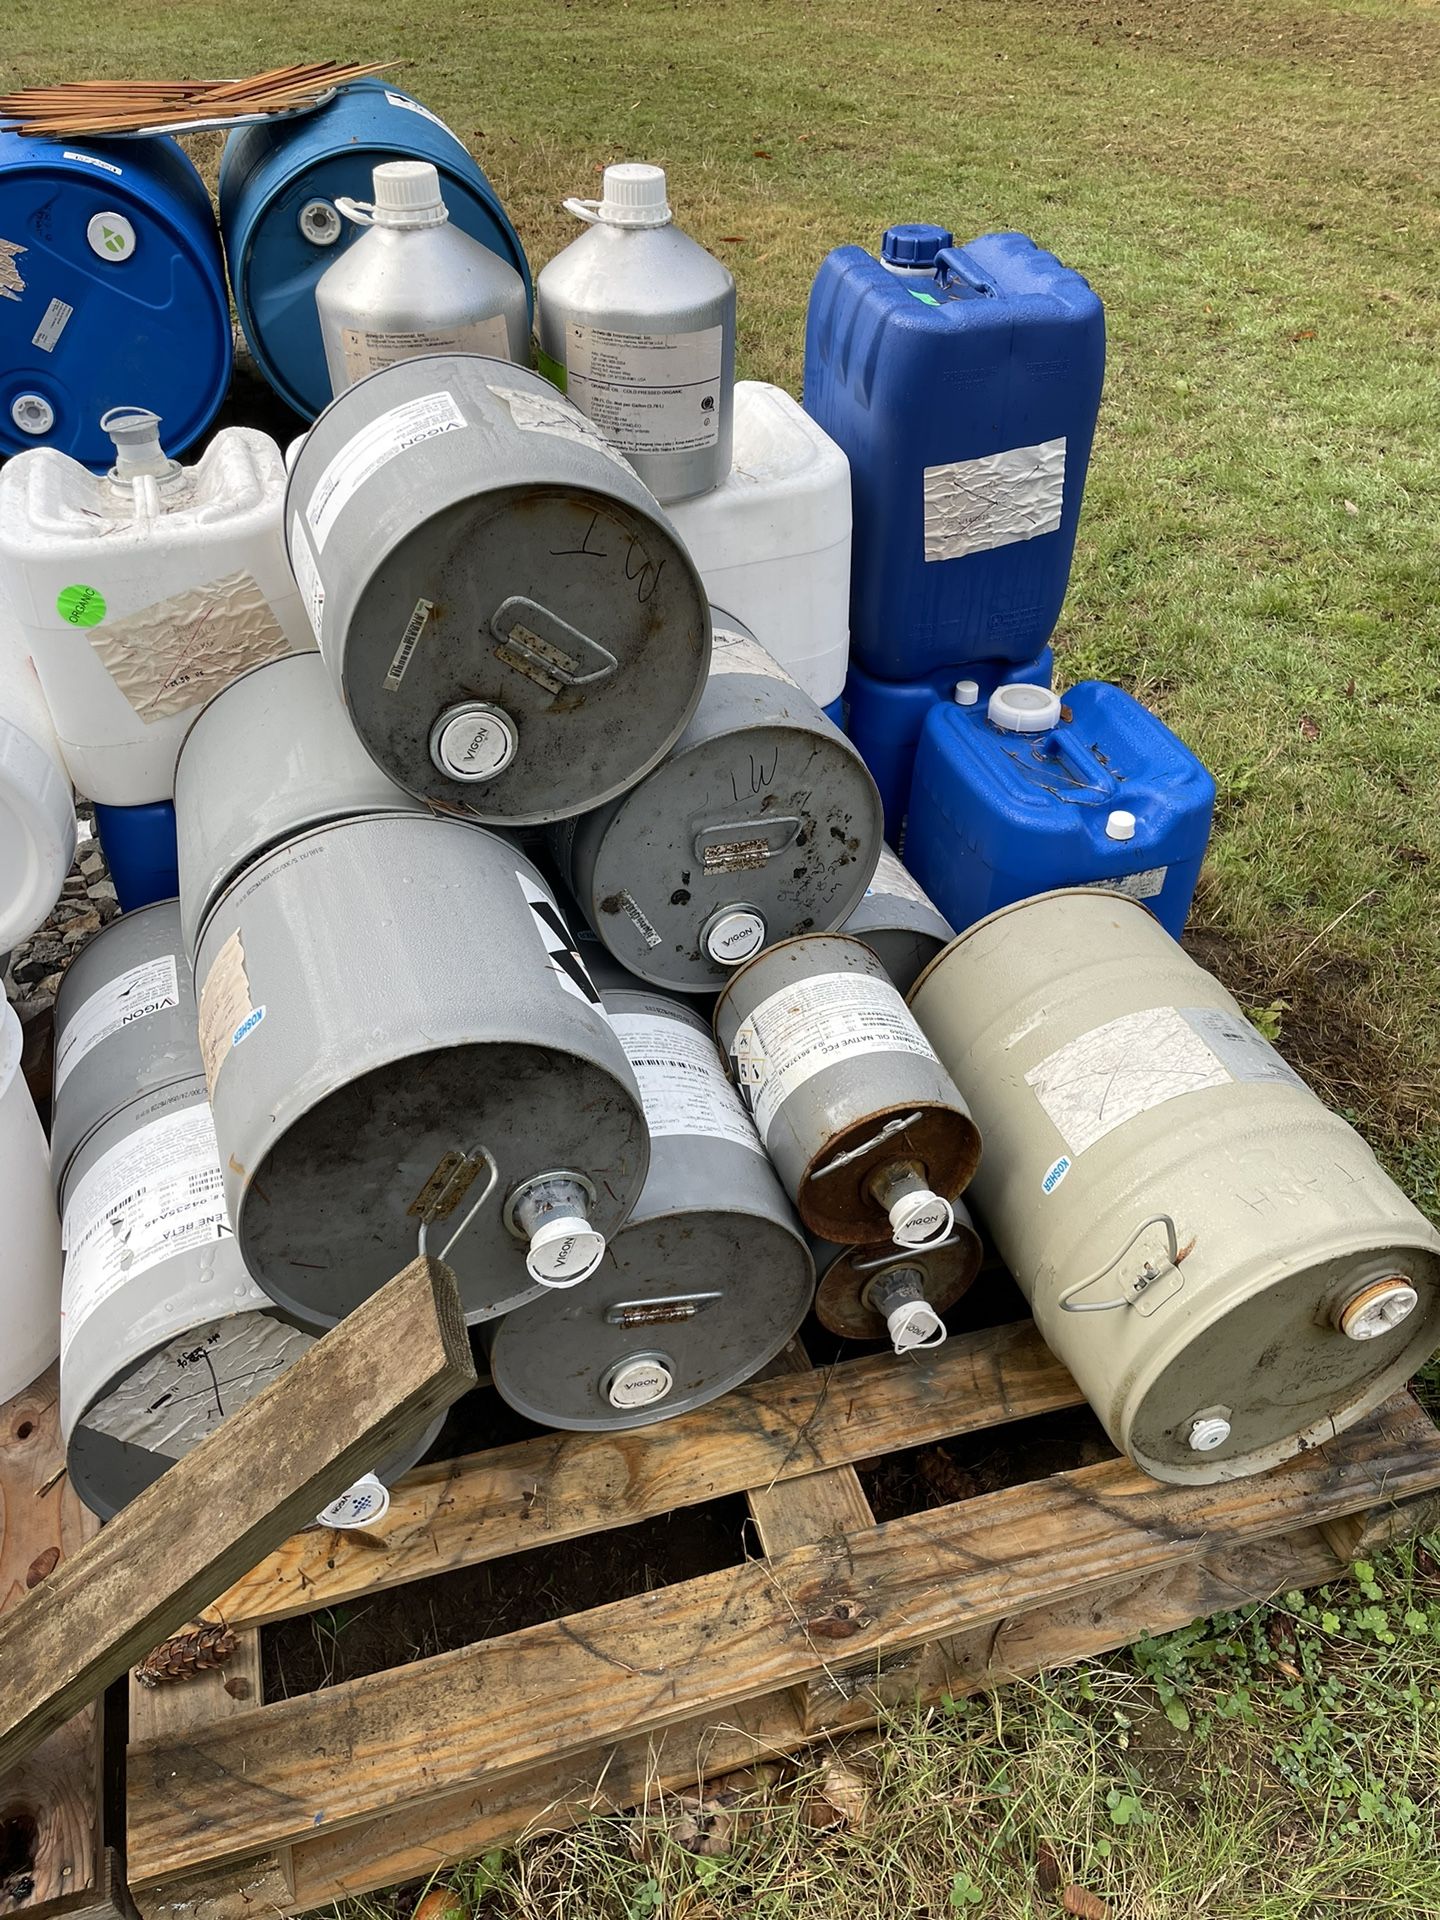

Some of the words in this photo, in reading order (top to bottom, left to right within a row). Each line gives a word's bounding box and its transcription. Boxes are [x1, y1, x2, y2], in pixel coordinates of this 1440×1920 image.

[401, 423, 460, 449] VIGON
[68, 588, 96, 624] ORGANIC
[463, 727, 488, 760] VIGON
[721, 927, 753, 948] VIGON
[122, 997, 175, 1024] VIGON
[234, 1008, 263, 1044] KOSHER
[821, 1042, 840, 1054] FCC
[842, 1034, 875, 1047] NATIVE
[1043, 1158, 1070, 1192] KOSHER
[905, 1215, 939, 1229] VIGON
[553, 1237, 575, 1268] VIGON
[625, 1378, 658, 1390] VIGON
[331, 1494, 352, 1514] VIGON
